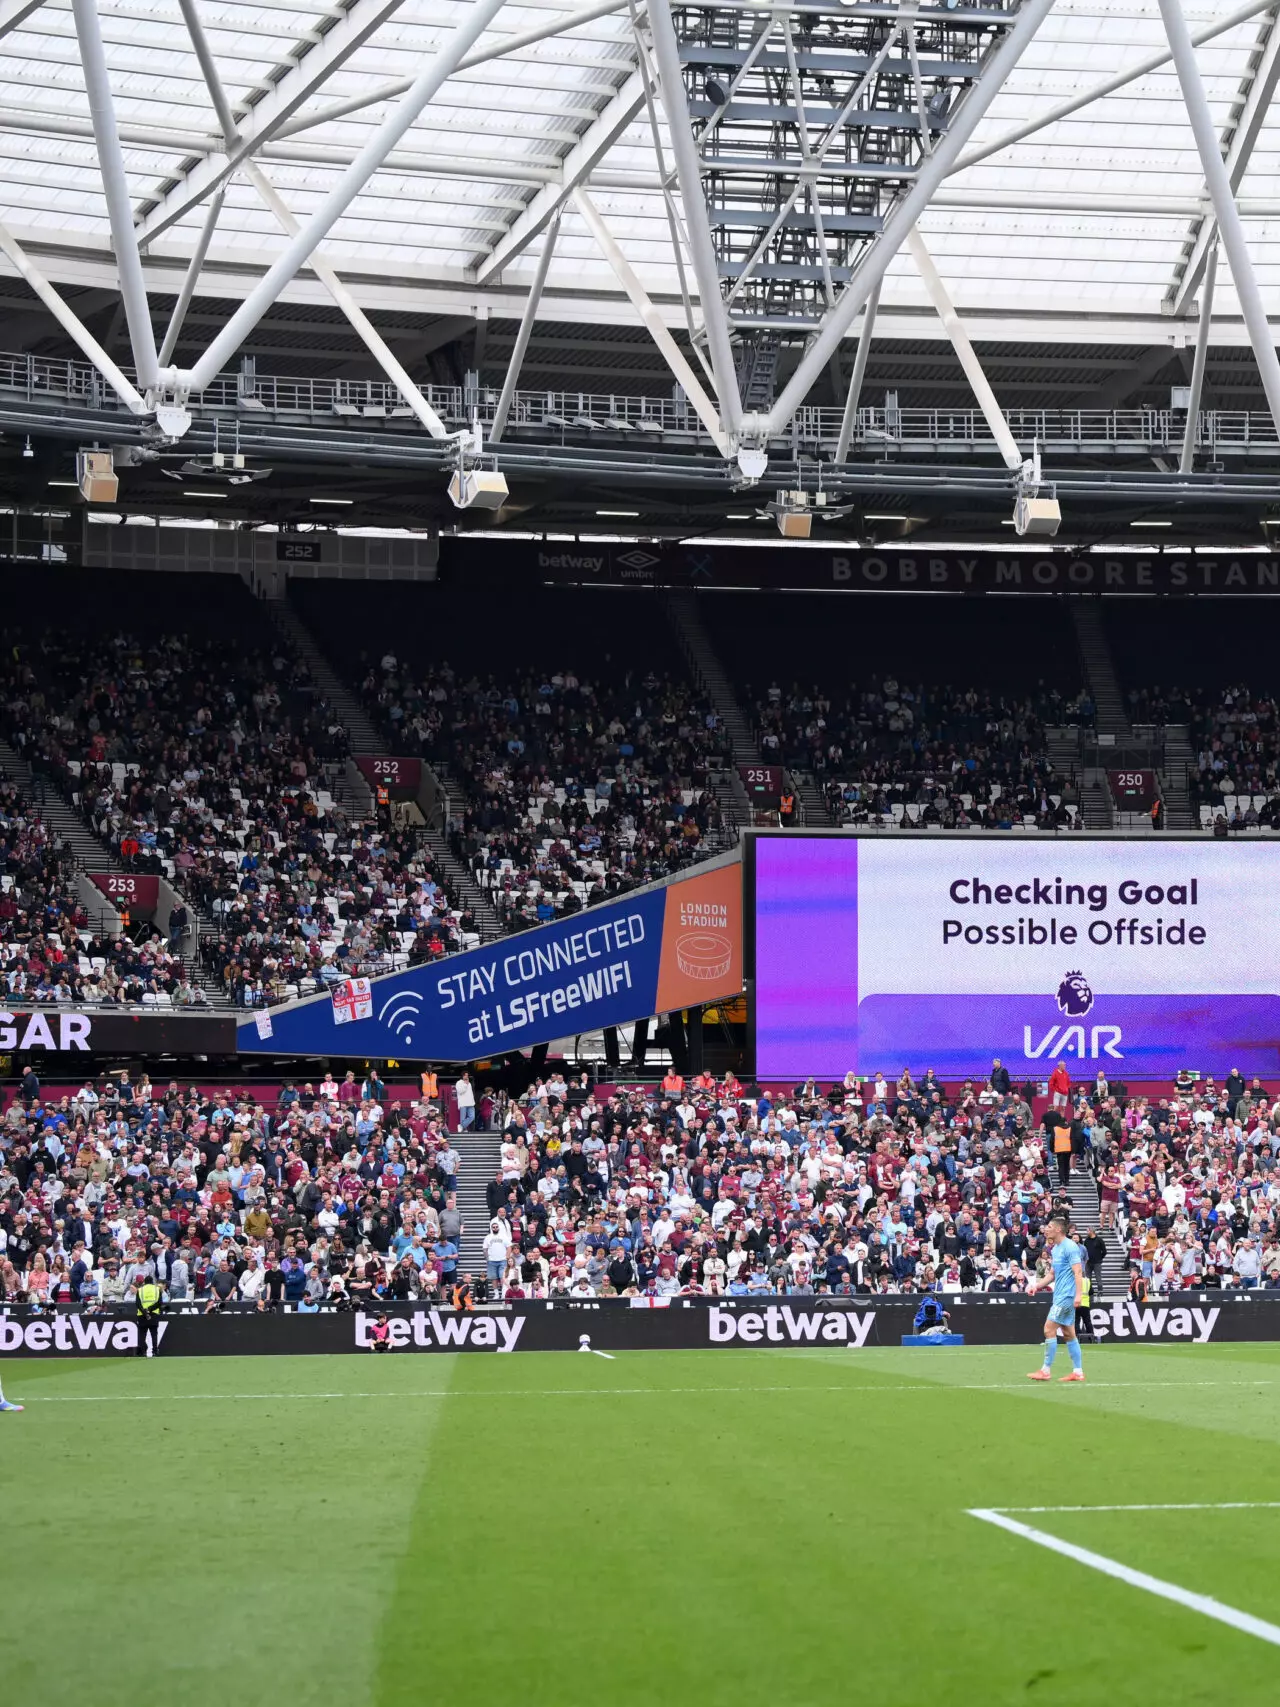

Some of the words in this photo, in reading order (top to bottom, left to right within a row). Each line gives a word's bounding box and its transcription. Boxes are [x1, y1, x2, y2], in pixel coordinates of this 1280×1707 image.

[285, 545, 313, 558] 252
[538, 553, 604, 572] betway
[832, 557, 978, 582] BOBBY
[996, 560, 1154, 584] MOORE
[374, 761, 399, 774] 252
[747, 770, 772, 782] 251
[1118, 773, 1143, 786] 250
[108, 879, 135, 892] 253
[949, 877, 1108, 912] Checking
[1118, 878, 1198, 905] Goal
[680, 902, 727, 916] LONDON
[680, 914, 727, 928] STADIUM
[942, 918, 1078, 945] Possible
[1088, 918, 1207, 945] Offside
[436, 962, 498, 1010] STAY
[503, 913, 645, 986] CONNECTED
[468, 1010, 494, 1044] at
[495, 960, 633, 1034] LSFreeWIFI
[1023, 1025, 1125, 1058] VAR
[709, 1305, 876, 1347] betway
[1056, 1301, 1220, 1343] etway
